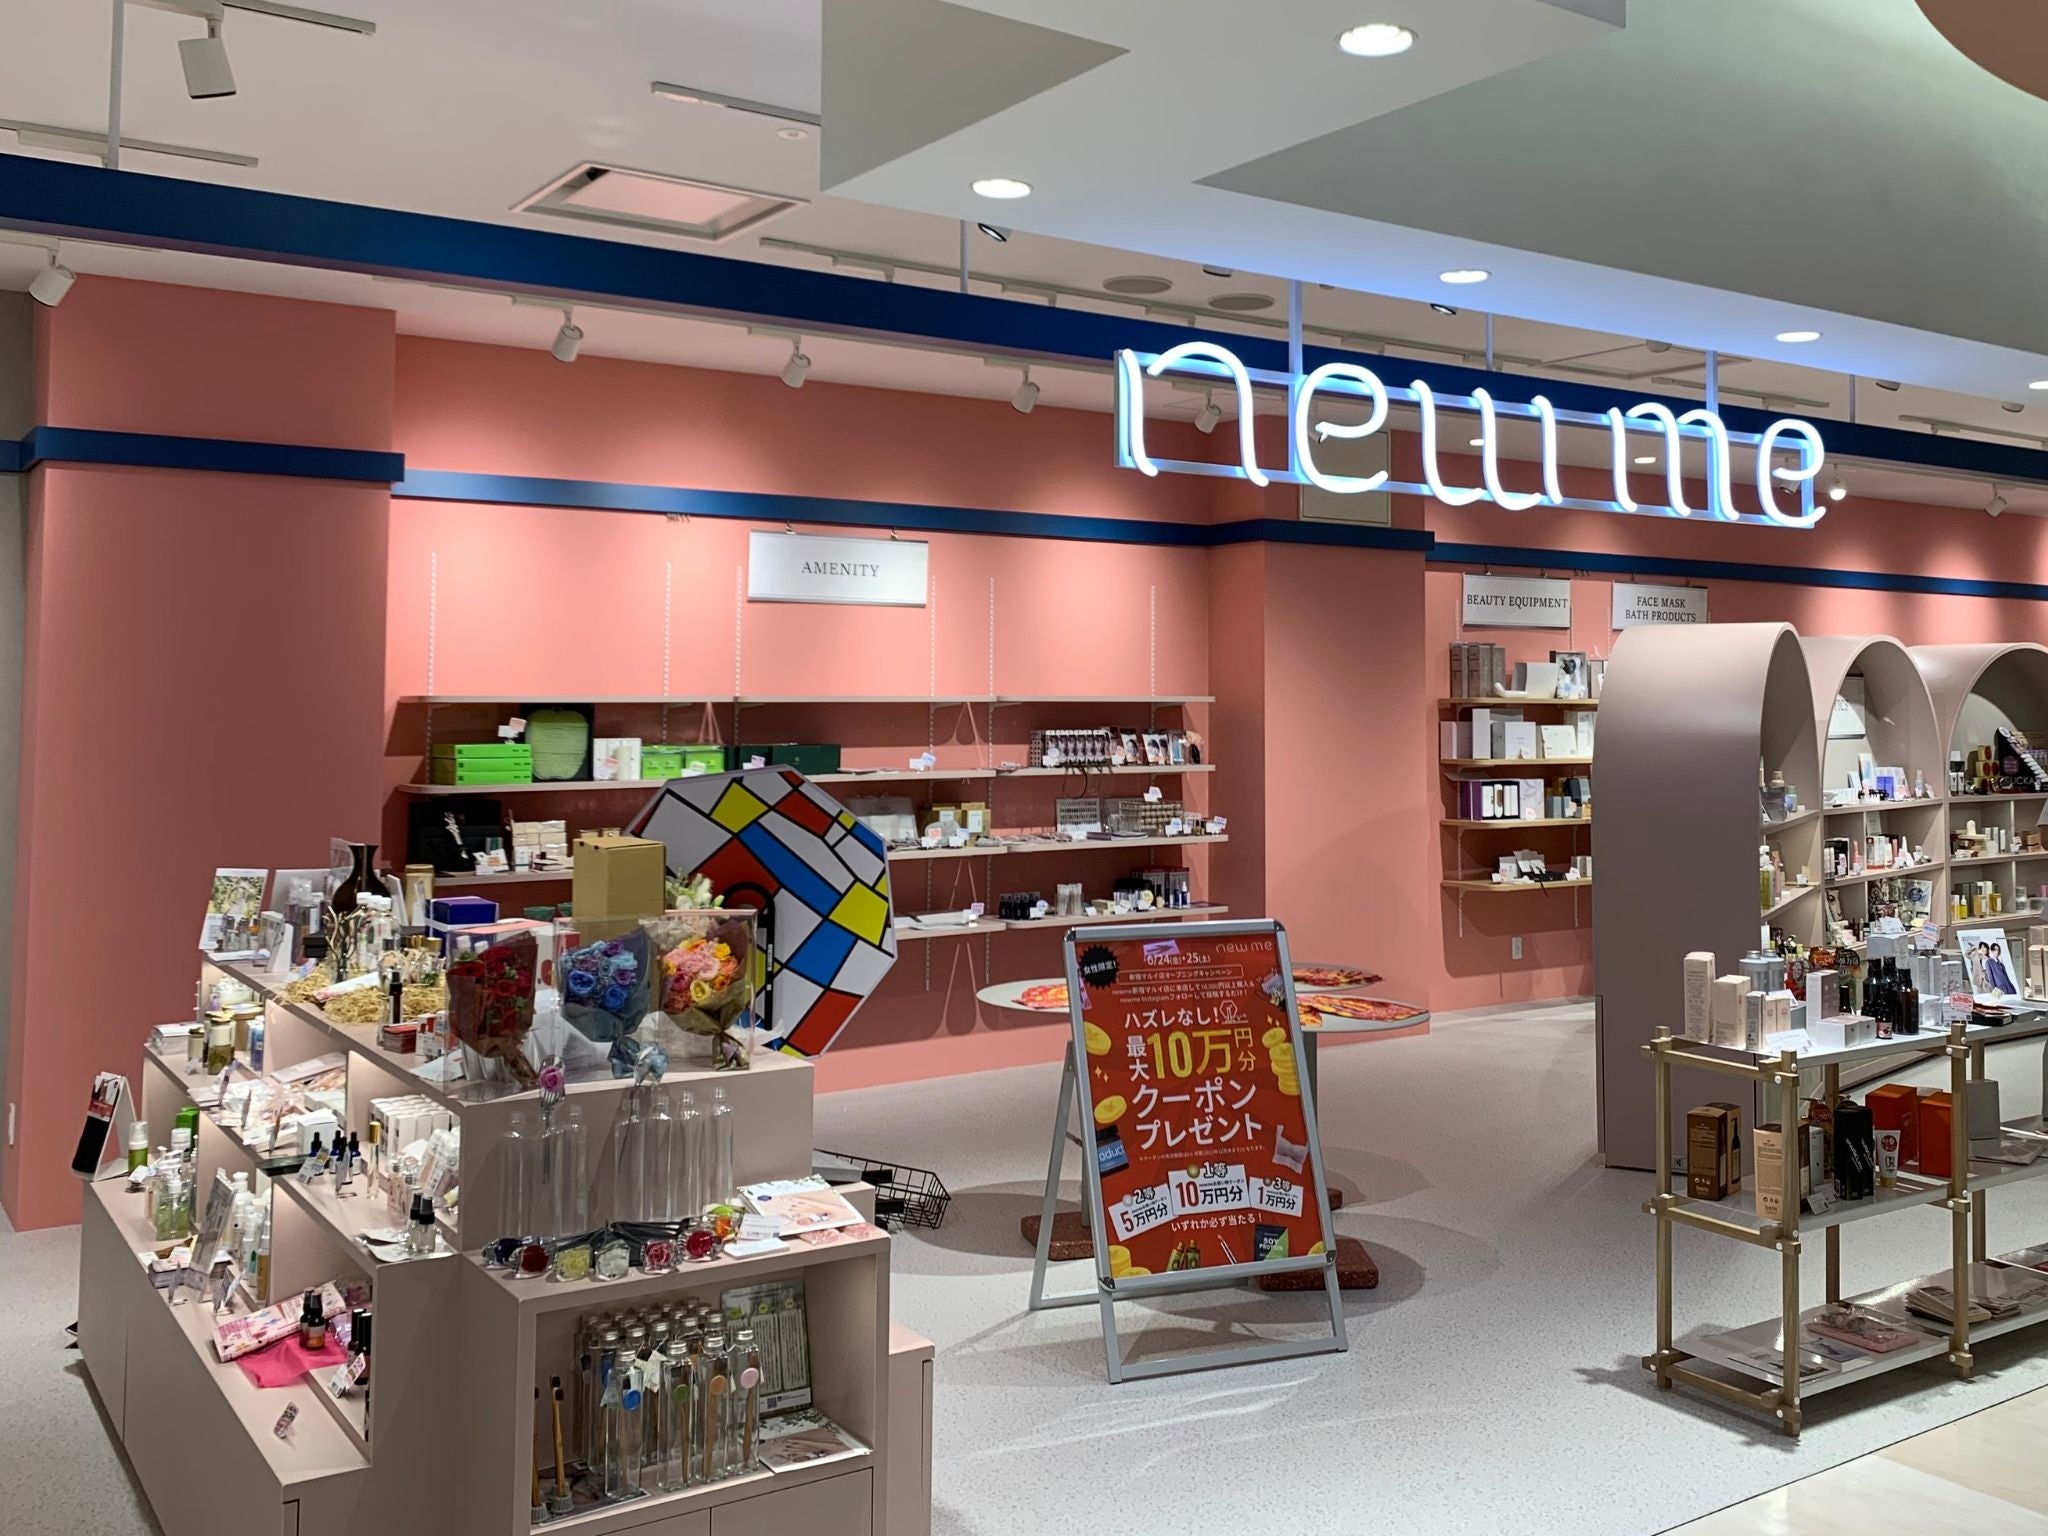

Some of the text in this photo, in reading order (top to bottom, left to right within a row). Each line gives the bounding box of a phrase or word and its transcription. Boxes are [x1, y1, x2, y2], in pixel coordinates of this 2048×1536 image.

[801, 561, 880, 577] AMENITY
[1466, 594, 1569, 610] BEAUTY EQUIPMENT
[1636, 596, 1686, 609] FACE MASK
[1625, 609, 1697, 623] BATH PRODUCTS
[1132, 1076, 1257, 1119] クーポン
[1136, 1112, 1262, 1150] プレゼント
[1175, 1181, 1243, 1208] 10万円分
